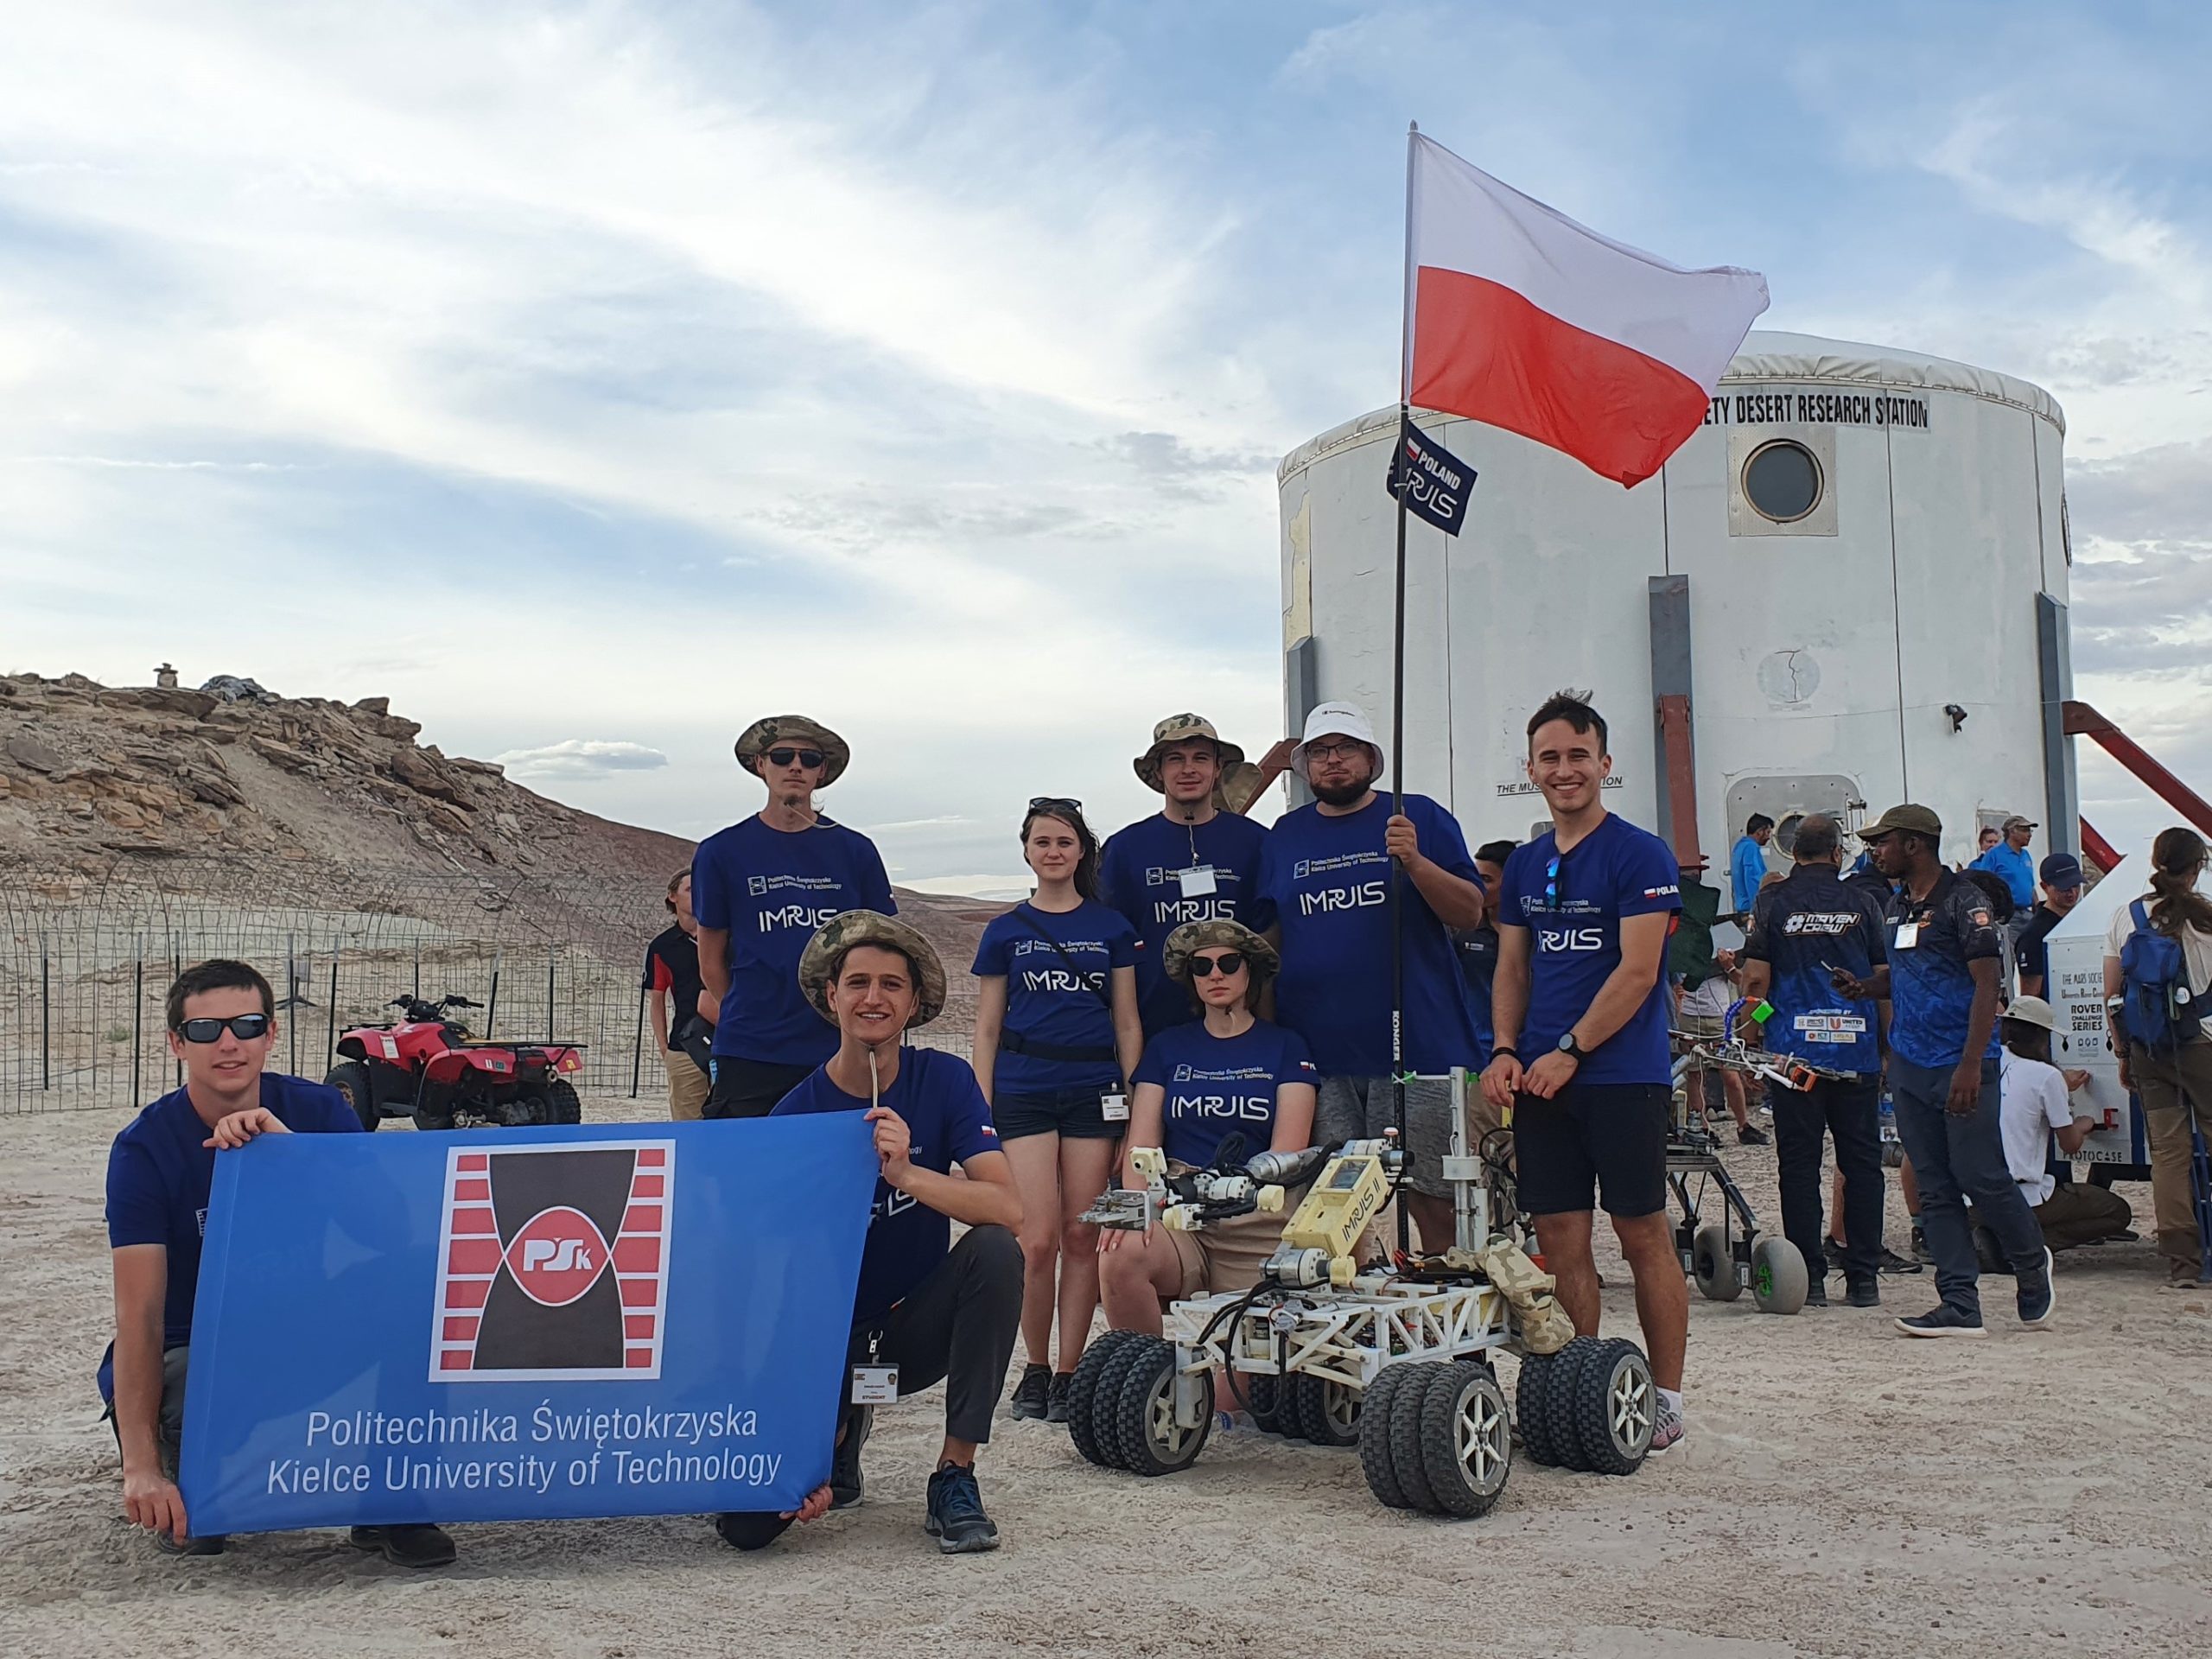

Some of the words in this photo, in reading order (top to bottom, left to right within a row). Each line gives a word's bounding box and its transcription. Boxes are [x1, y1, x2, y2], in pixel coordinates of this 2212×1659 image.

[1736, 394, 1793, 423] DESERT
[1798, 394, 1871, 424] RESEARCH
[1876, 397, 1928, 428] STATION
[1418, 450, 1461, 491] POLAND
[1497, 783, 1517, 794] THE
[1518, 781, 1542, 792] MUS
[1300, 880, 1386, 916] IMPULS
[1806, 913, 1857, 924] MAVEN
[2088, 972, 2102, 984] SOCIE
[2070, 1004, 2102, 1014] ROVER
[2072, 1021, 2102, 1031] SERIES
[1171, 1095, 1269, 1122] IMPULS
[306, 1408, 518, 1446] Politechnika
[531, 1398, 757, 1449] Świętokrzyska
[267, 1458, 371, 1495] Kielce
[385, 1453, 556, 1494] University
[568, 1451, 601, 1485] of
[611, 1447, 782, 1486] Technology
